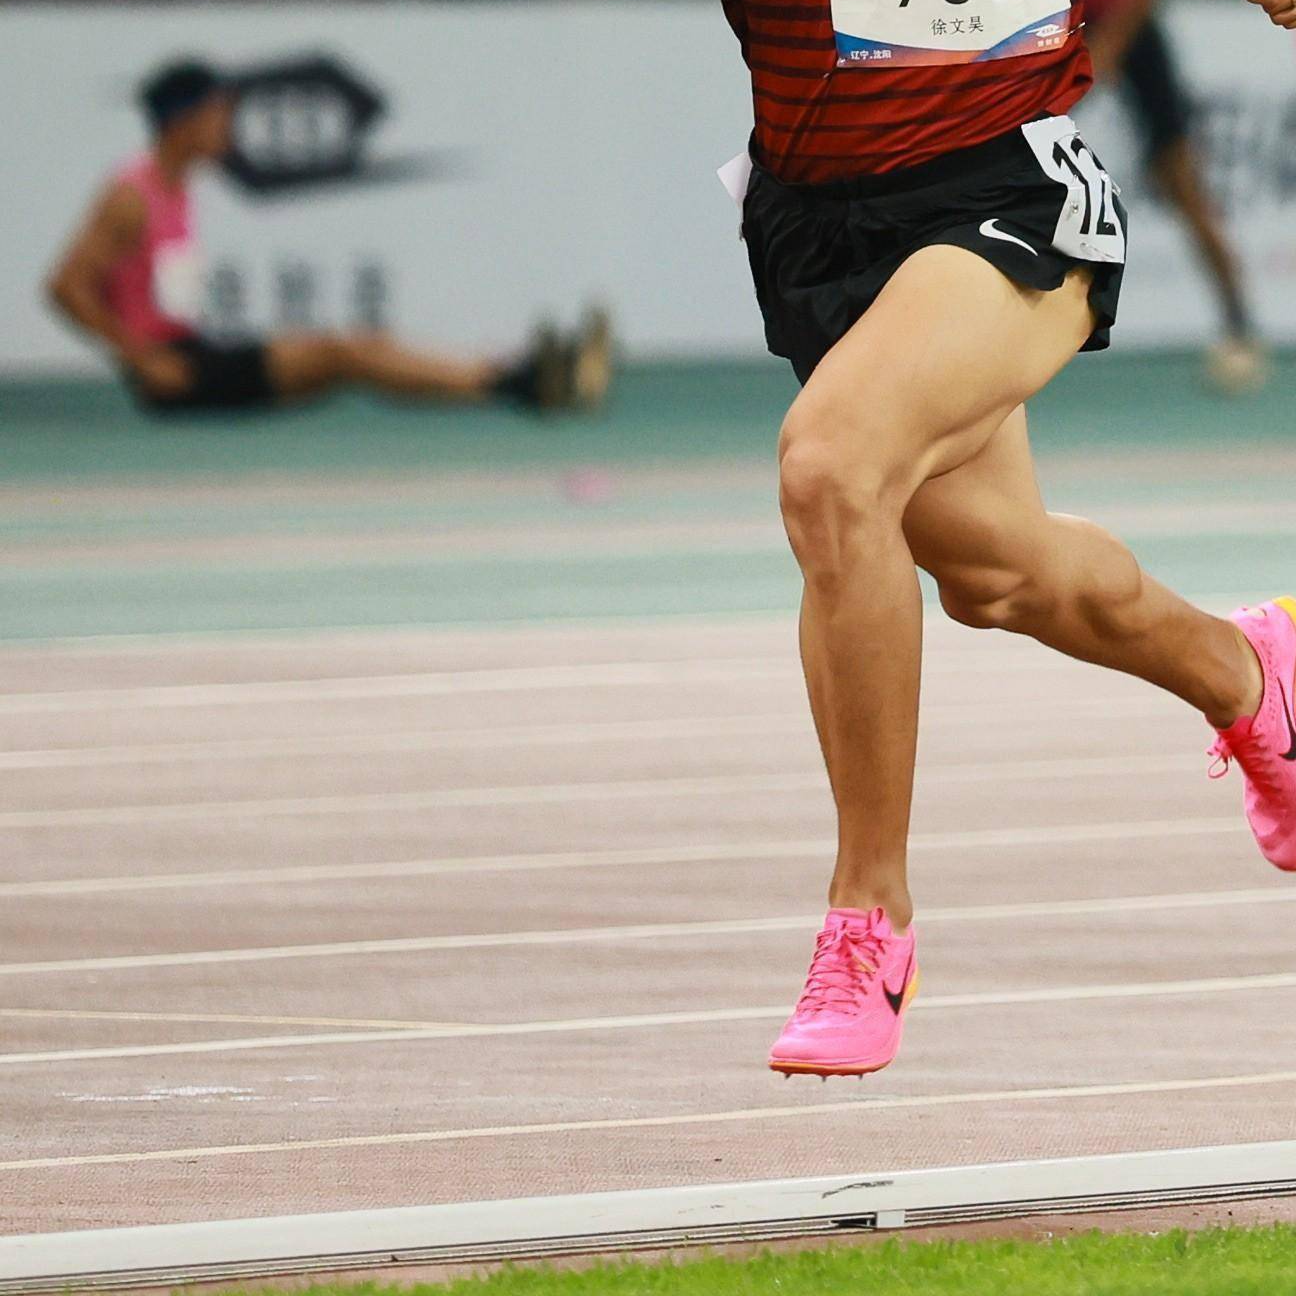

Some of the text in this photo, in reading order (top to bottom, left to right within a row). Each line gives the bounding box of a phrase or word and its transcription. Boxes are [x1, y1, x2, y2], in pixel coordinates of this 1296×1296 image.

[931, 16, 984, 36] 徐文昊
[1052, 137, 1117, 235] 12
